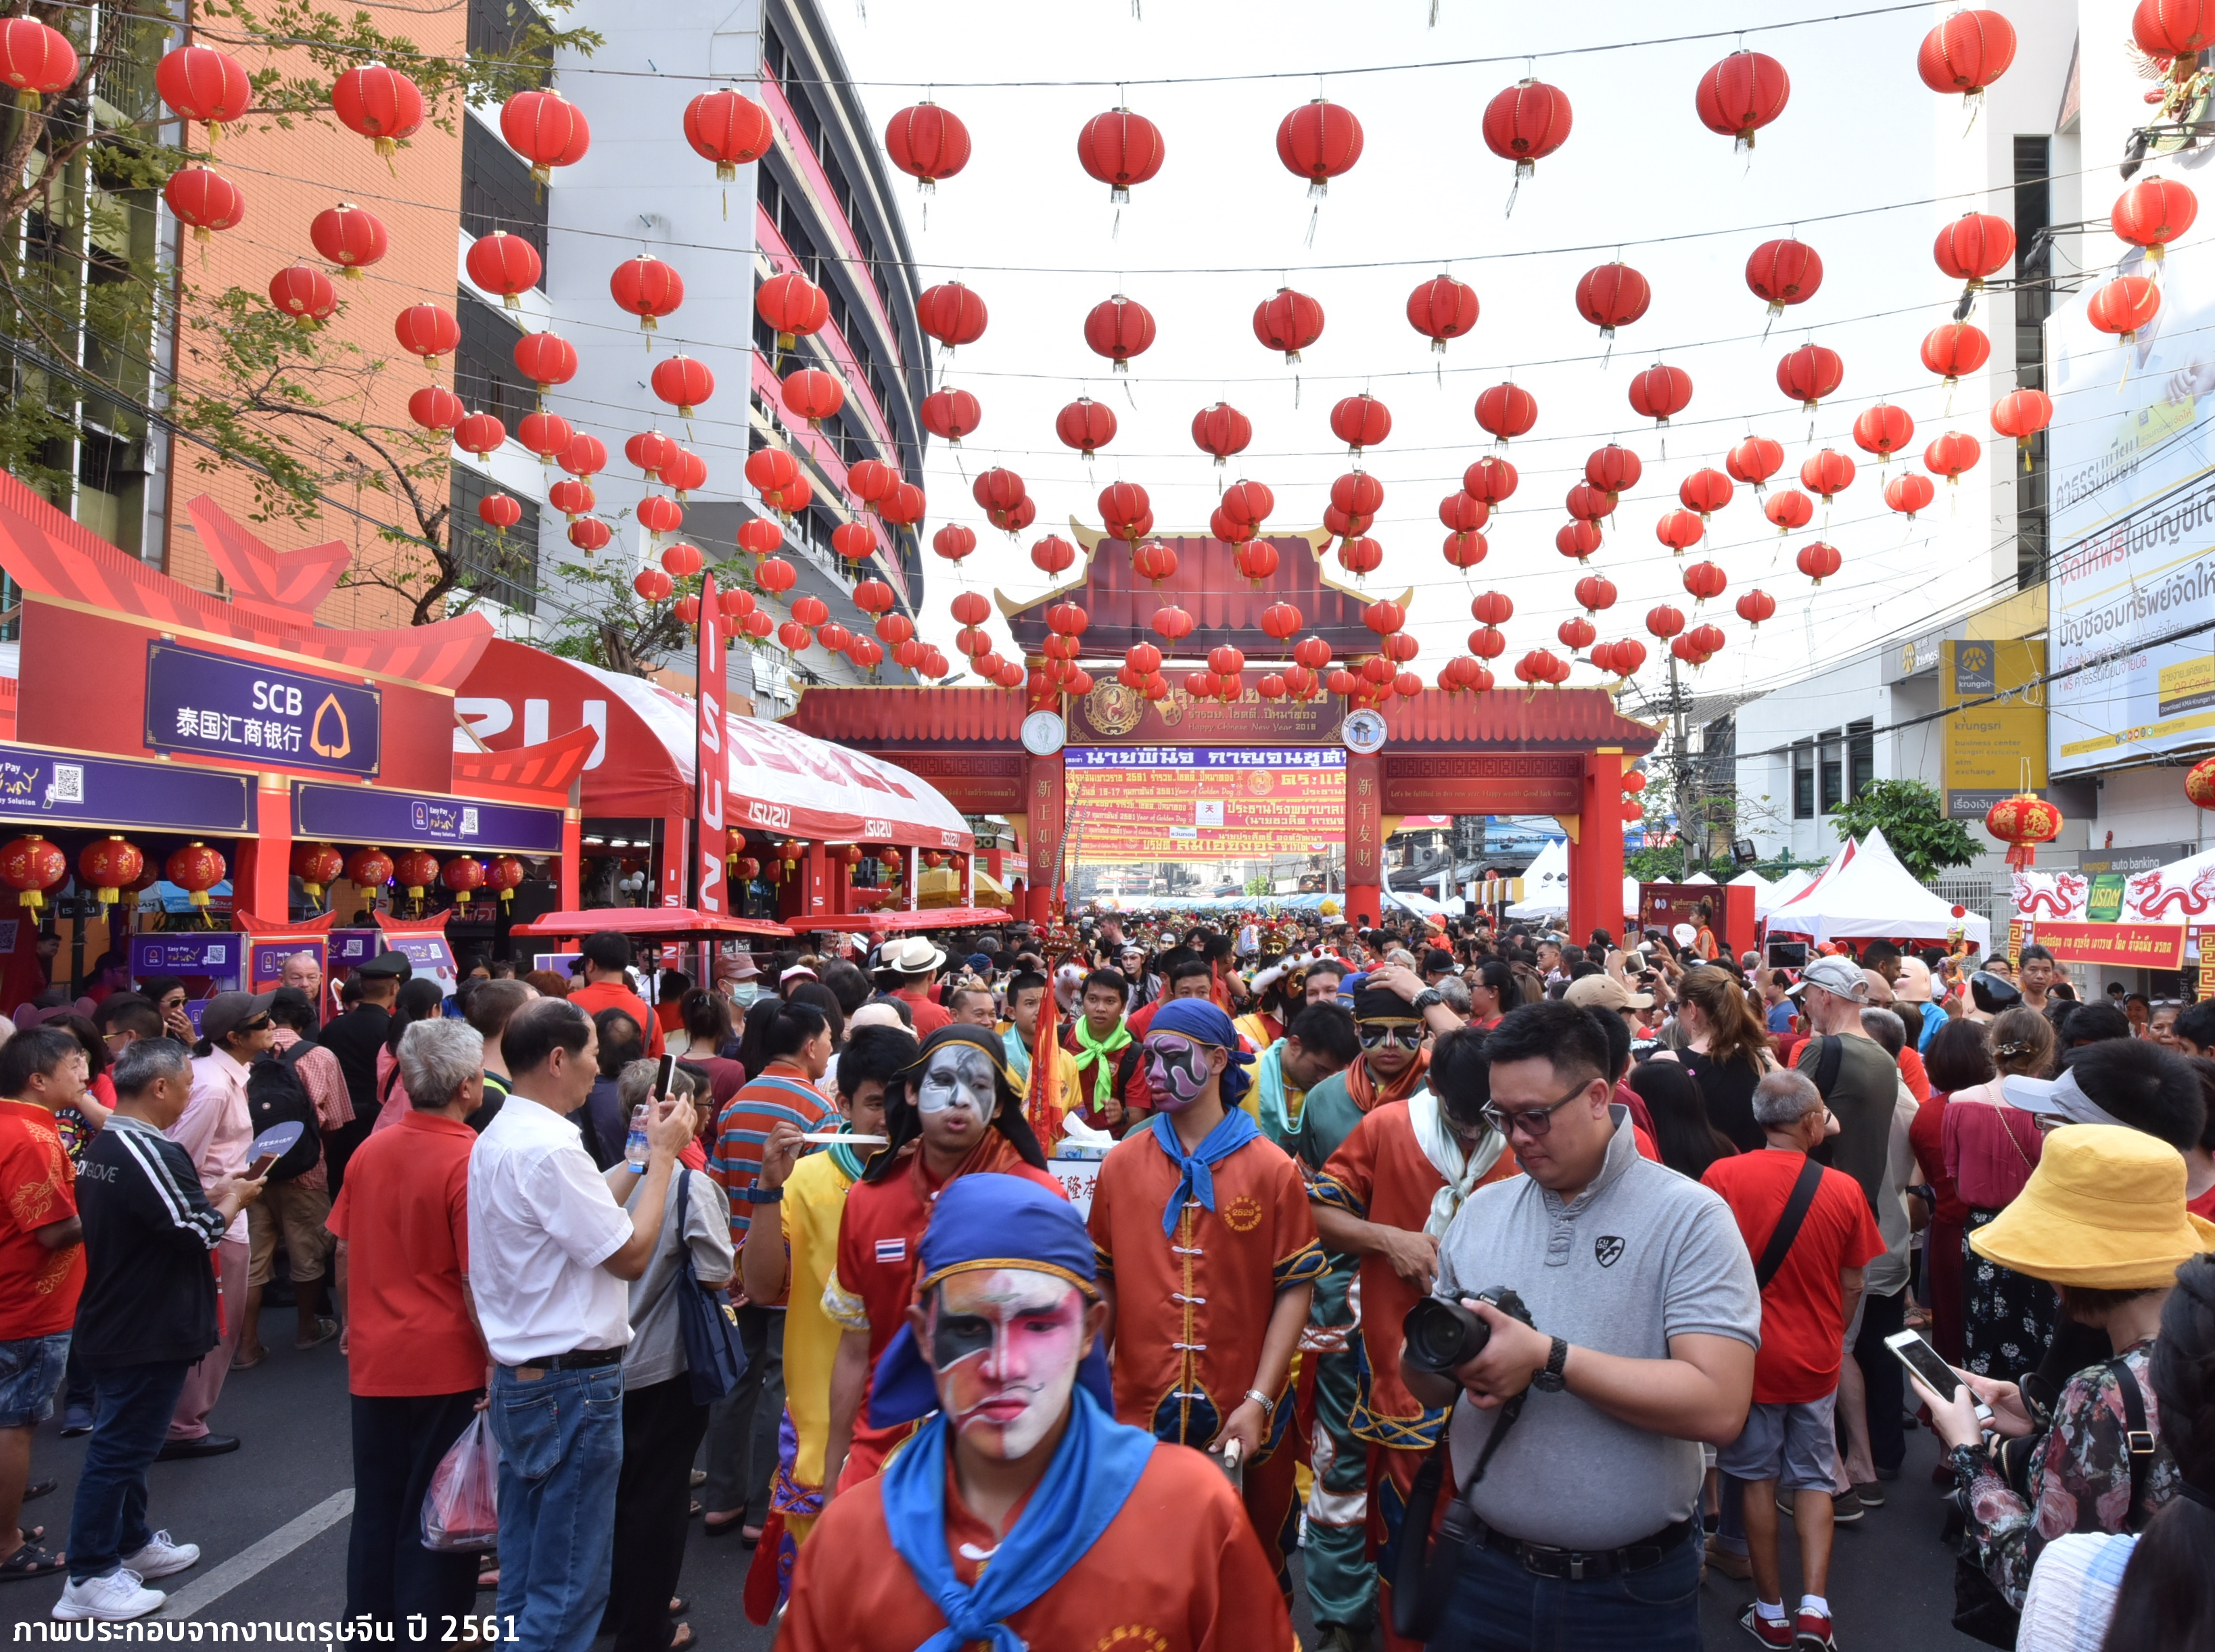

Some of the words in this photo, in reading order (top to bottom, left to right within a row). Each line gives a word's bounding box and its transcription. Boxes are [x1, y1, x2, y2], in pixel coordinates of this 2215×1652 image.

[1959, 680, 1990, 688] krungsri
[2174, 681, 2187, 694] QR
[2189, 676, 2211, 690] Code
[252, 680, 302, 716] SCB
[2161, 703, 2181, 713] Download
[176, 707, 302, 753] 泰国汇商银行
[1188, 723, 1214, 732] Happy
[1273, 723, 1292, 732] Year
[1955, 721, 2002, 732] krungsri
[5, 763, 20, 774] Pay
[1175, 786, 1189, 796] Year
[1191, 786, 1197, 797] of
[1198, 786, 1219, 795] Golden
[1221, 787, 1234, 797] Dog
[1483, 790, 1501, 799] Happy
[7, 797, 36, 806] Solution
[1953, 796, 1993, 809] เรื่องเงิน
[429, 807, 440, 816] Easy
[440, 808, 448, 816] Pay
[748, 801, 791, 829] ISUZU
[1150, 811, 1156, 822] of
[1176, 815, 1186, 824] Dog
[864, 819, 892, 838] ISUZU
[1035, 779, 1053, 868] 新正如意
[1355, 778, 1374, 867] 新年发财
[941, 830, 960, 847] ISUZU
[2082, 859, 2110, 873] krungsri
[2112, 858, 2128, 871] auto
[2130, 856, 2160, 870] banking
[2089, 888, 2122, 908] มรกต
[1480, 1294, 1497, 1306] Canon
